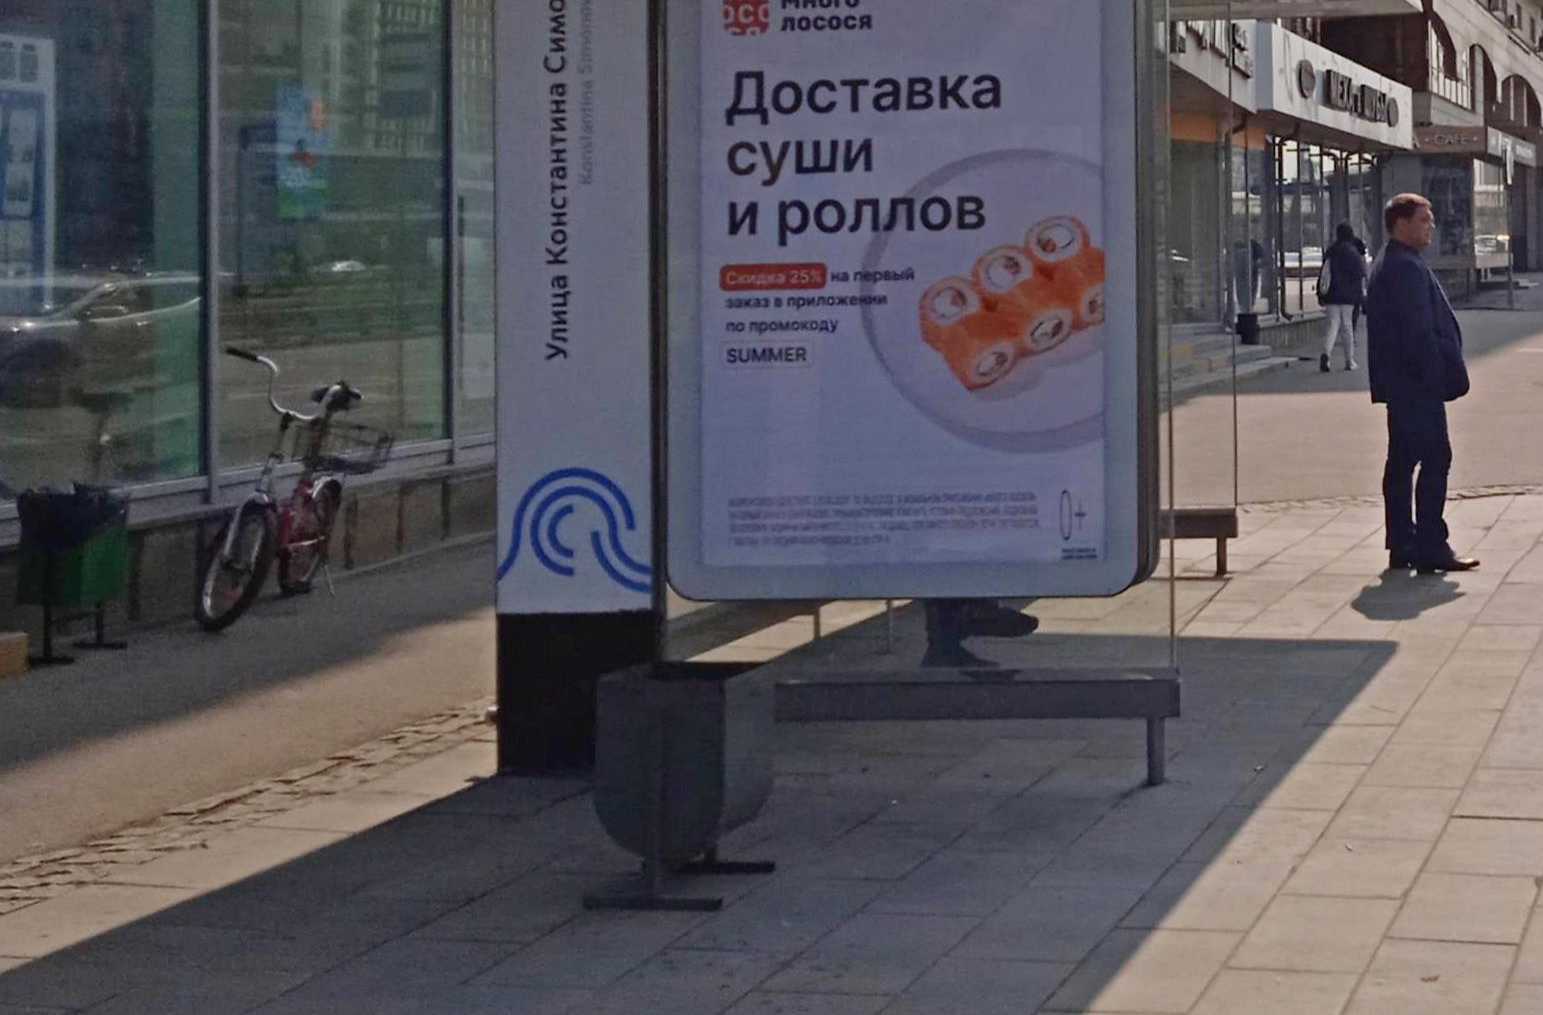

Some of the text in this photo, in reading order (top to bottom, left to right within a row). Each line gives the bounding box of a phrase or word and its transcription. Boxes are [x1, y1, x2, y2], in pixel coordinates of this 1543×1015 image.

[781, 14, 872, 32] лосося
[725, 70, 1002, 125] Доставка
[577, 80, 595, 186] Konstantina
[544, 82, 569, 266] Константина
[727, 138, 874, 186] суши
[728, 195, 986, 245] и роллов
[726, 267, 915, 287] Скидка 25% на первый
[544, 274, 571, 361] Улица
[725, 294, 888, 310] заказ в приложении
[726, 319, 838, 335] по промокоду
[726, 346, 807, 363] SUMMER
